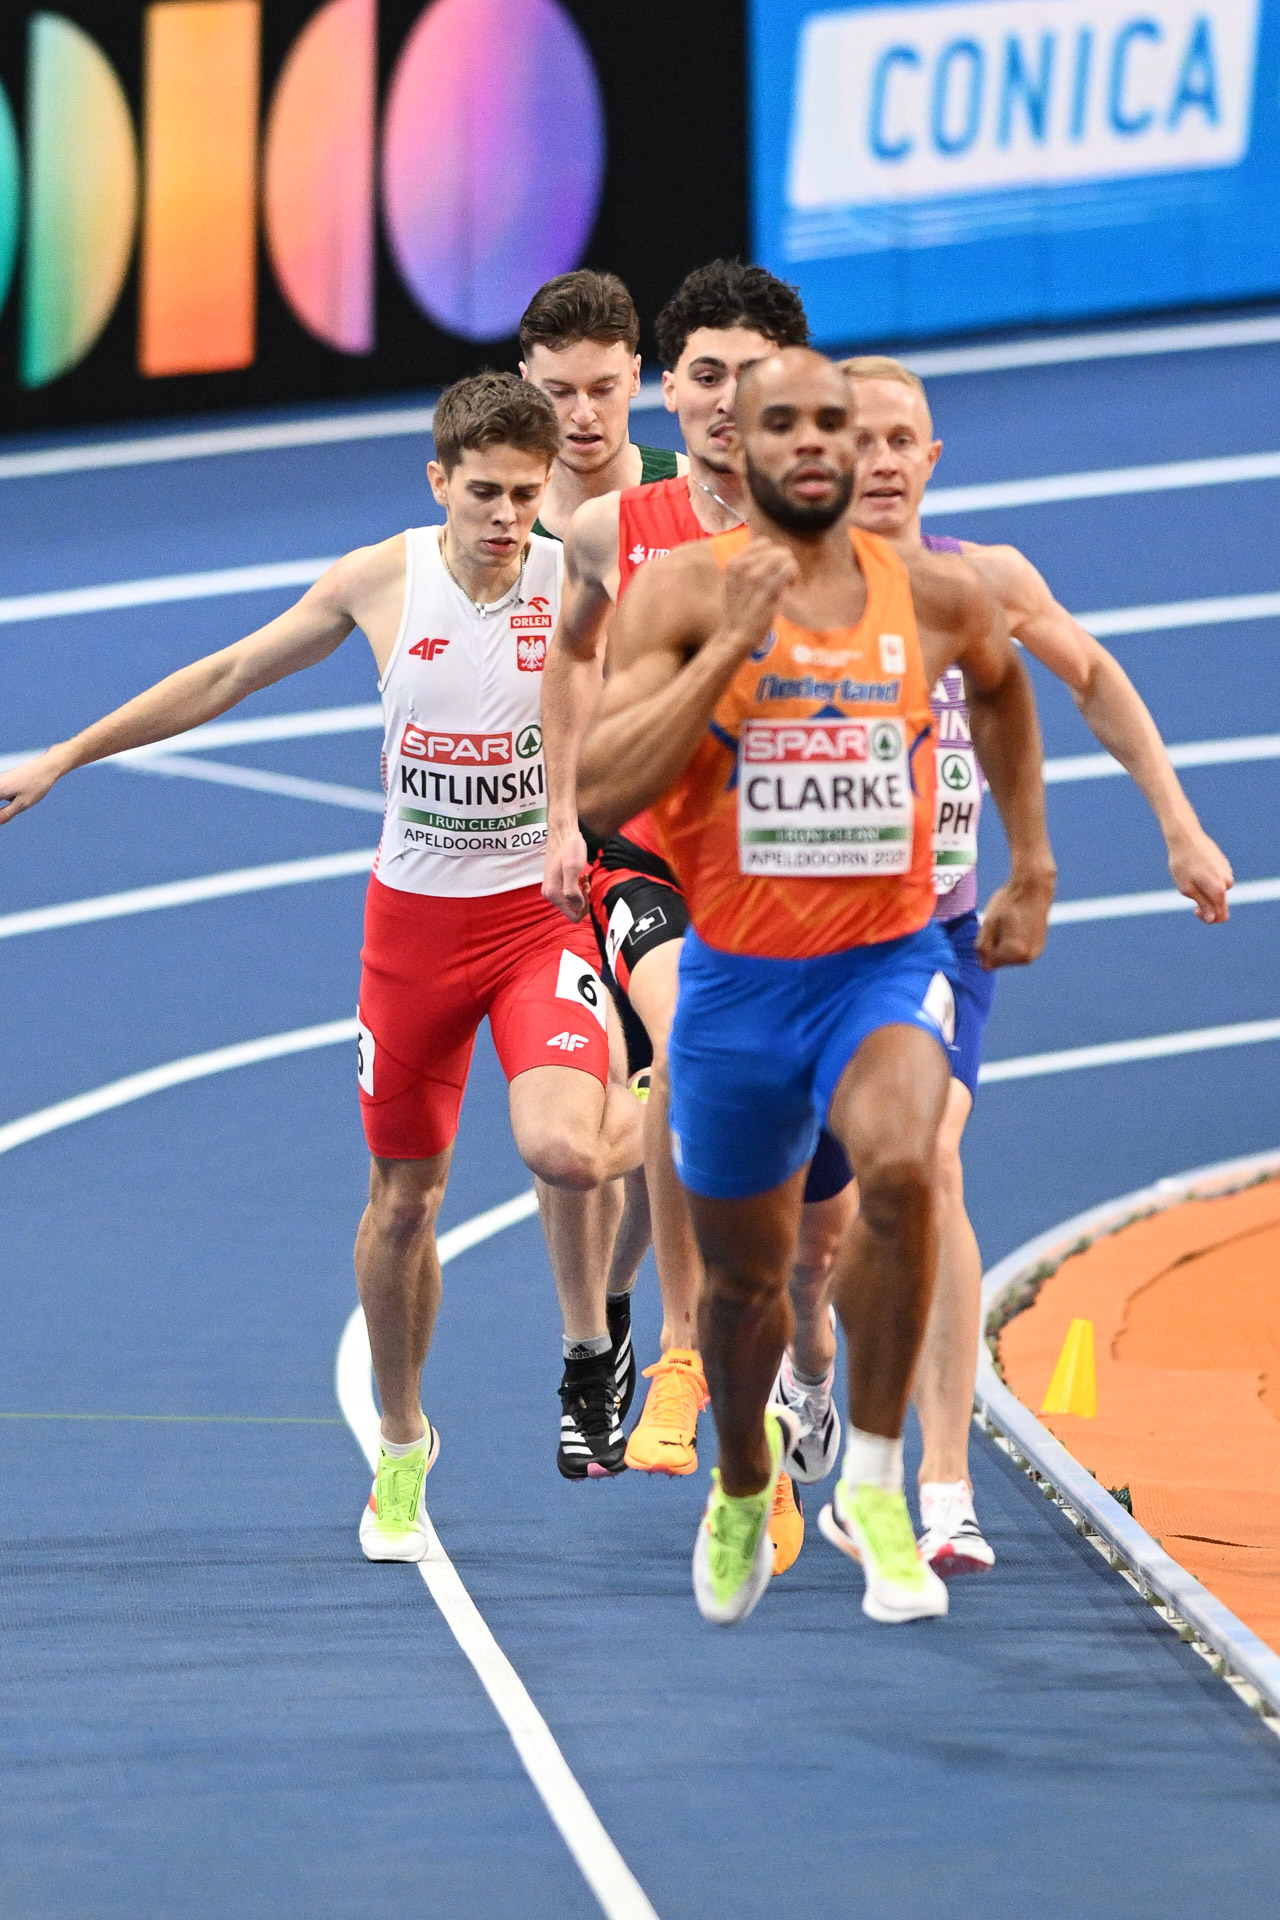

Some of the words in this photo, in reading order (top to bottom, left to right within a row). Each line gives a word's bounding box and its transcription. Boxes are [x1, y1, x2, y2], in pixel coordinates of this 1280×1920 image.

[868, 16, 1222, 163] CONICA
[512, 616, 550, 627] ORLEN
[408, 637, 450, 661] 4F
[402, 729, 509, 761] SPAR
[746, 729, 867, 760] SPAR
[401, 763, 544, 806] KITLINSKI
[747, 775, 903, 811] CLARKE
[429, 814, 433, 825] I
[436, 815, 466, 830] RUN
[404, 828, 507, 850] APELDOORN
[577, 974, 599, 1007] 6
[546, 1032, 589, 1052] 4F
